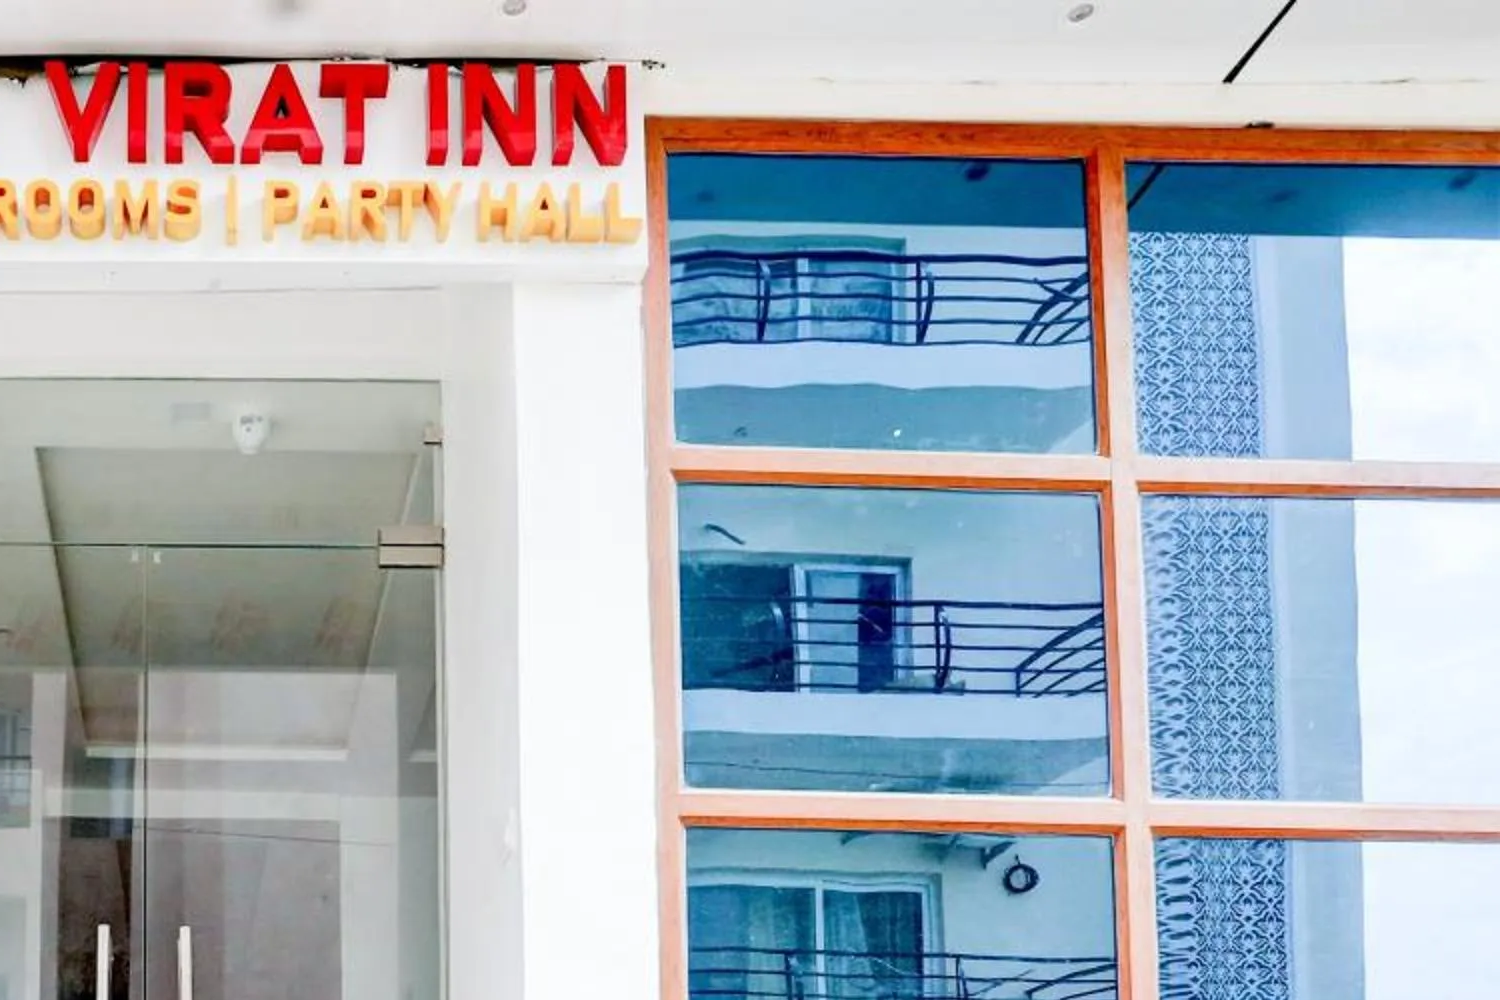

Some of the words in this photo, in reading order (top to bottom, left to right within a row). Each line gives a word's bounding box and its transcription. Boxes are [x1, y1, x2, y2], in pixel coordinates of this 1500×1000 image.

[44, 60, 390, 165] VIRAT
[426, 63, 627, 166] INN
[263, 180, 461, 244] PARTY
[477, 182, 644, 245] HALL
